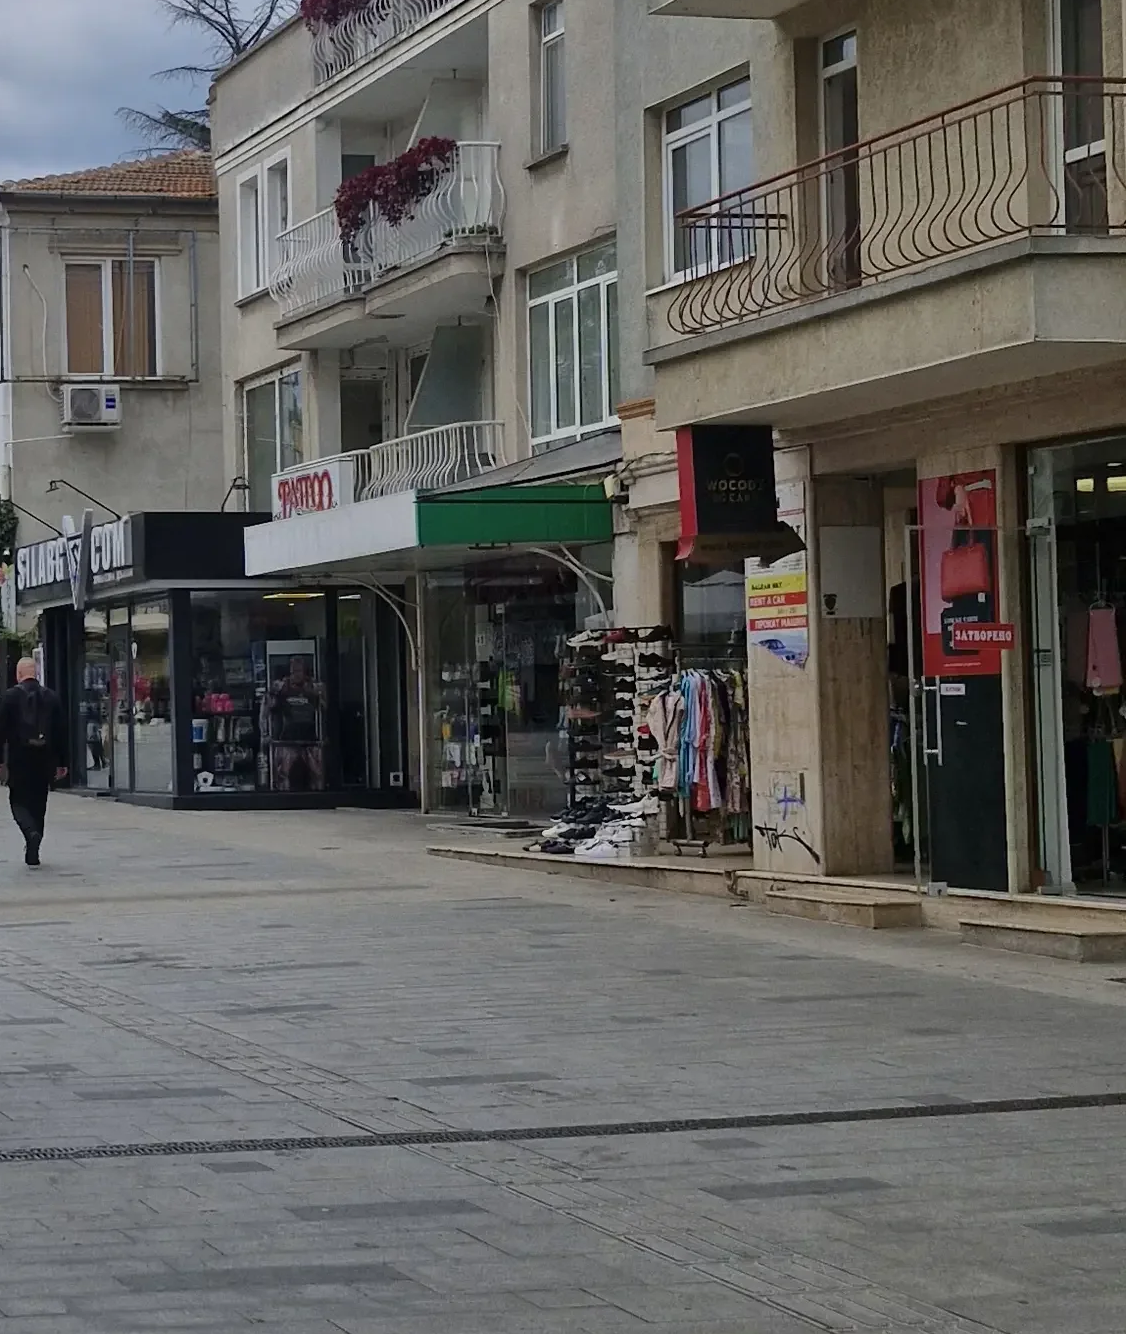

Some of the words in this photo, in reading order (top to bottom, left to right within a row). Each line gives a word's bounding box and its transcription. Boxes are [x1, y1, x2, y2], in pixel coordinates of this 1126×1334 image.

[749, 596, 766, 607] RENT
[767, 595, 772, 605] A
[773, 594, 786, 605] CAR
[955, 630, 1012, 642] ЗАТВОРЕНО
